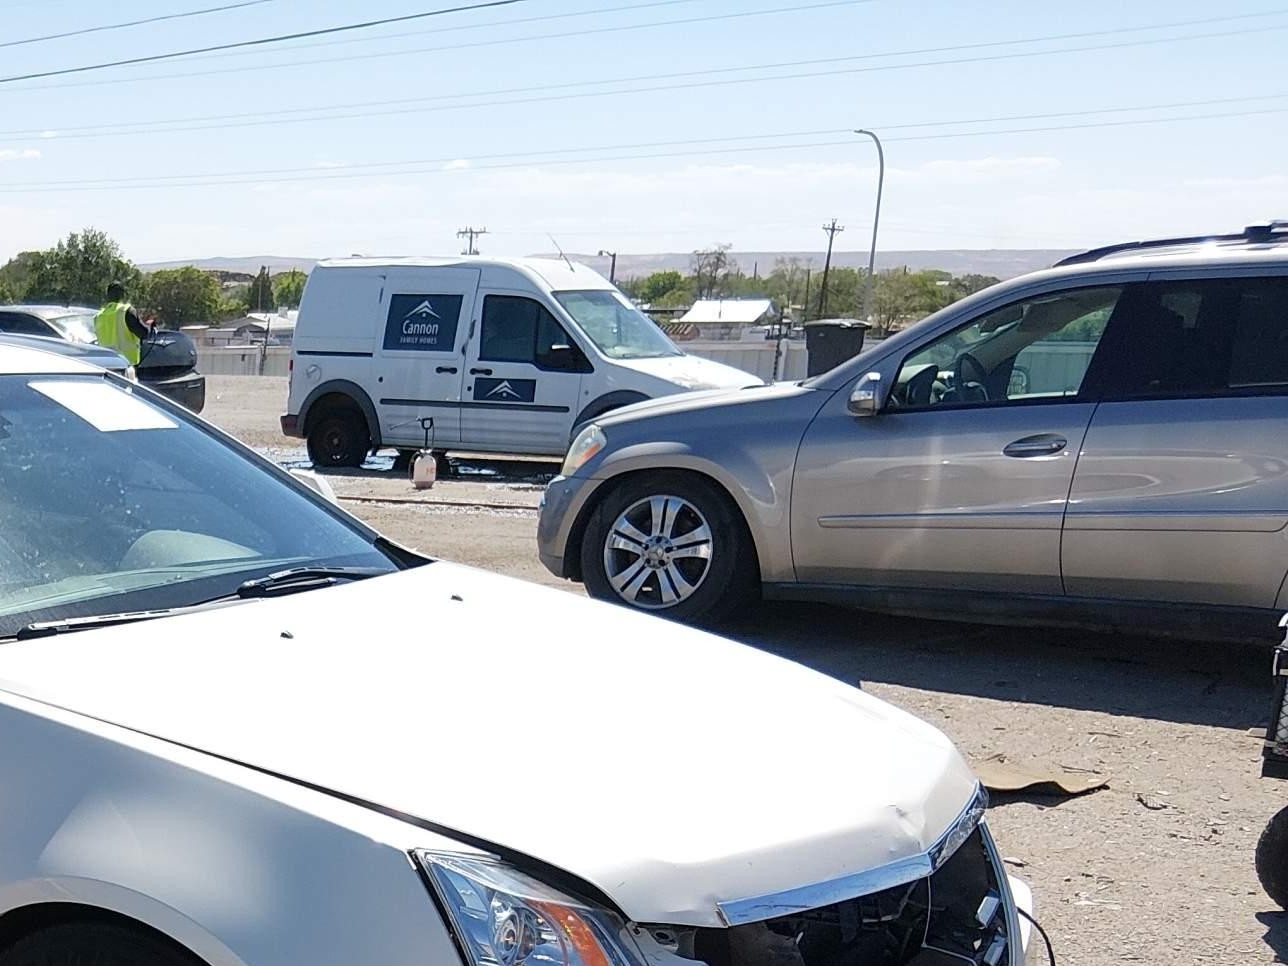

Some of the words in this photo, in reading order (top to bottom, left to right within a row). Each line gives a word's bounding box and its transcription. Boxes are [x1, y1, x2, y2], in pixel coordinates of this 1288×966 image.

[402, 320, 439, 335] Cannon
[400, 336, 419, 344] FAMILY
[419, 336, 438, 345] HOMES
